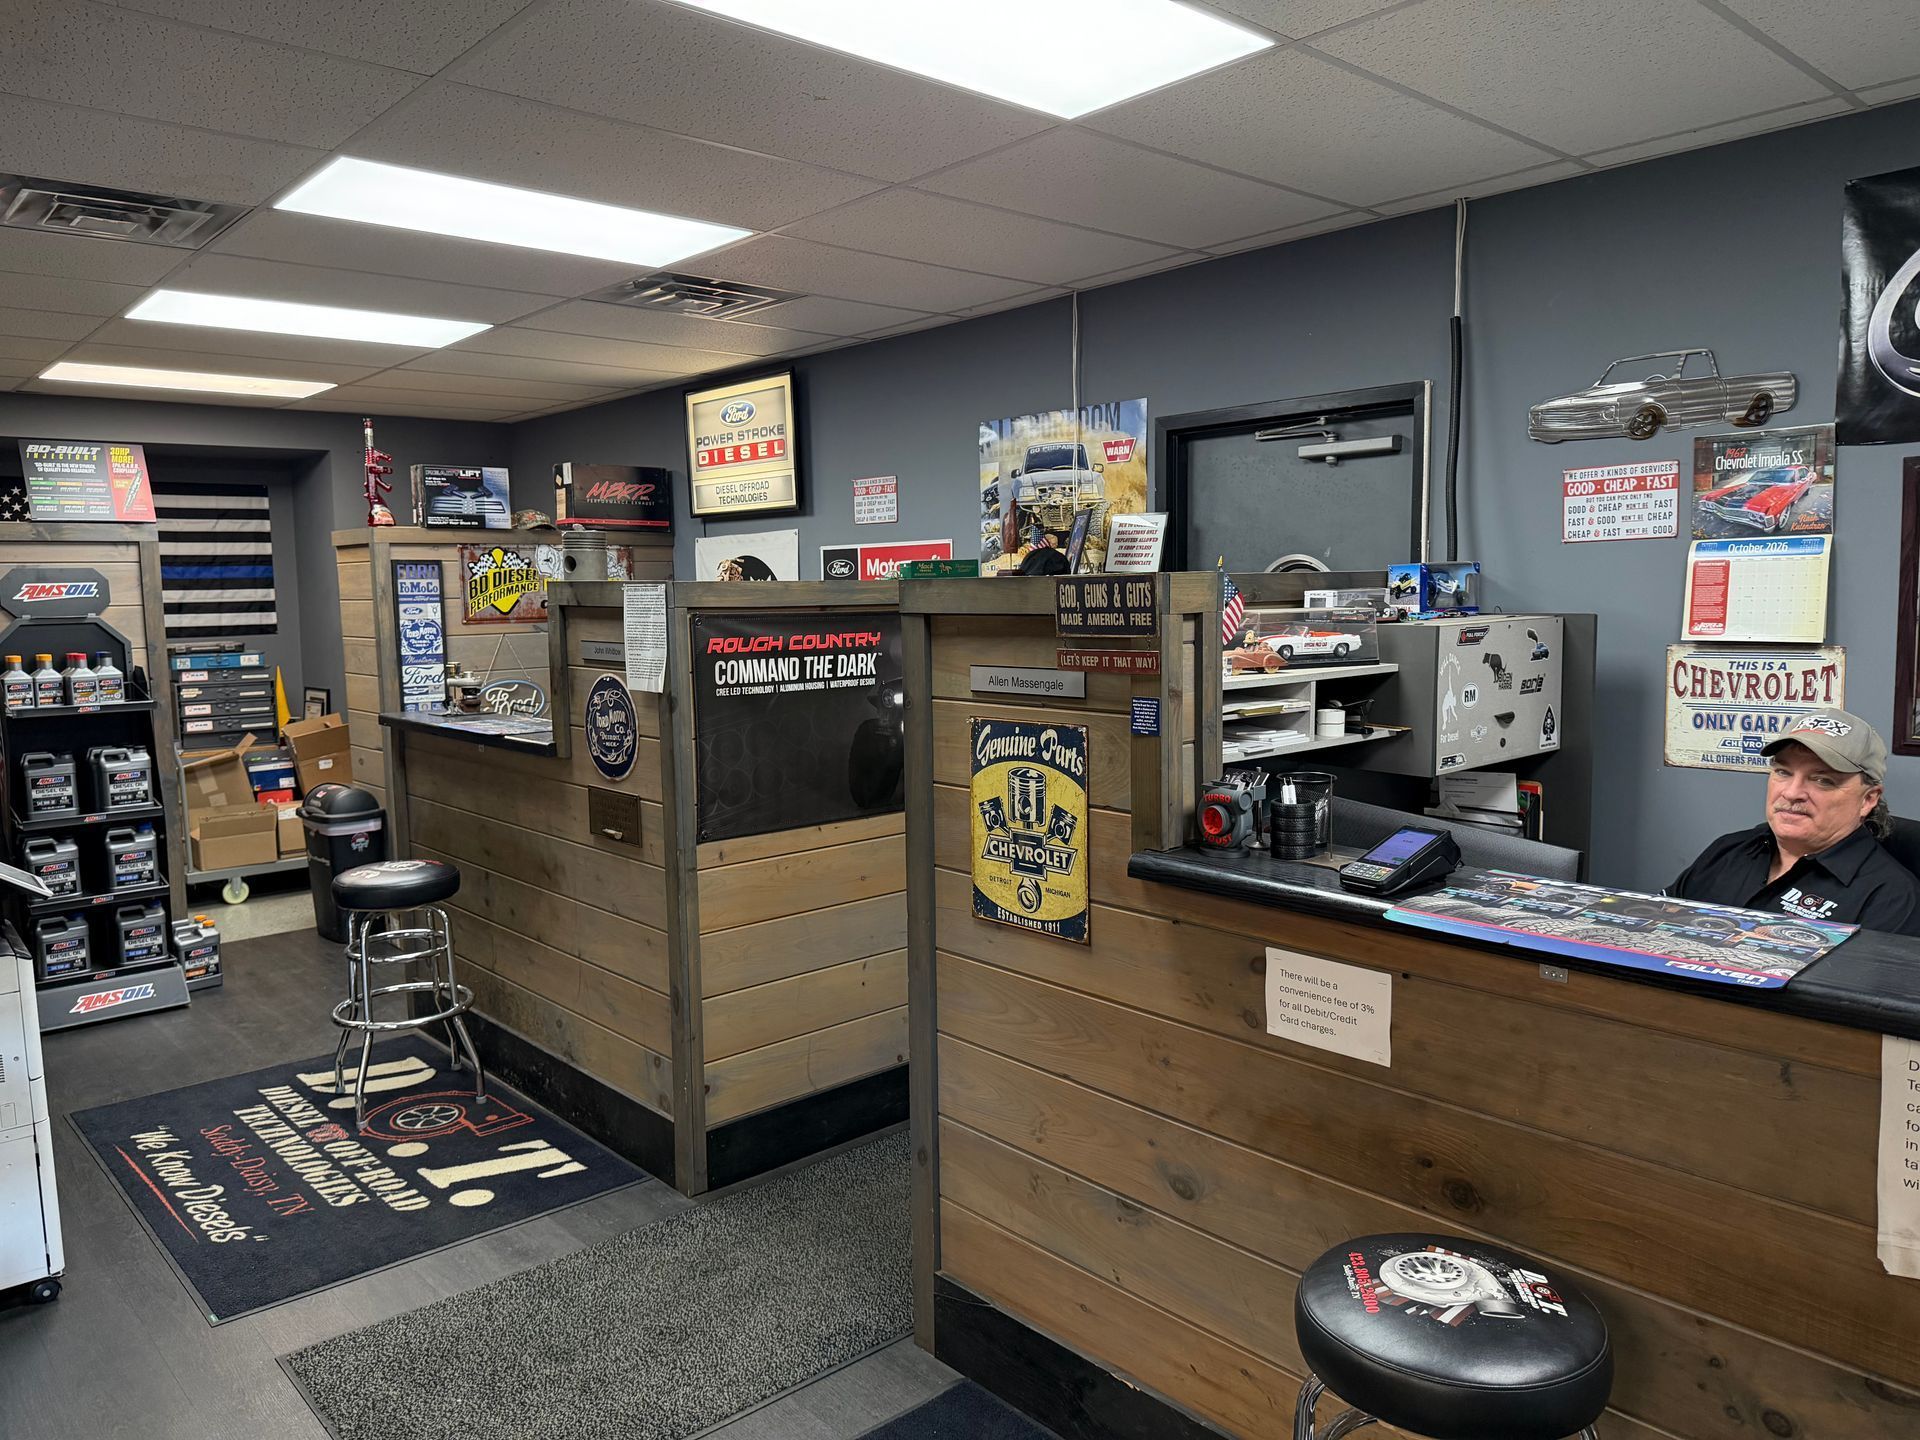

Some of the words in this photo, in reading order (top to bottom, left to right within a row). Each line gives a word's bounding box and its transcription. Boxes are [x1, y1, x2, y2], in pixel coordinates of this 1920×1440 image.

[726, 405, 749, 422] Ford
[696, 432, 734, 448] POWER
[737, 423, 785, 440] STROKE
[26, 444, 101, 455] BD-BUILT
[26, 452, 97, 461] INJECTORS
[699, 441, 784, 465] DIESEL
[1107, 446, 1130, 457] WARN
[1725, 447, 1748, 459] 1967
[112, 455, 134, 464] MORE!
[1715, 454, 1757, 470] Chevrolet
[1759, 451, 1790, 469] Impala
[1791, 450, 1803, 465] SS
[1568, 472, 1577, 480] WE
[1579, 470, 1598, 479] OFFER
[1600, 470, 1605, 478] 3
[1607, 468, 1628, 477] KINDS
[1629, 467, 1638, 475] OF
[1640, 464, 1673, 474] SERVICES
[586, 481, 655, 500] MBRP
[716, 483, 738, 495] DIESEL
[739, 481, 769, 492] OFFROAD
[1567, 483, 1596, 495] GOOD
[1603, 478, 1638, 493] CHEAP
[1646, 475, 1675, 489] FAST
[719, 492, 768, 505] TECHNOLOGIES
[1568, 505, 1586, 514] GOOD
[1589, 505, 1595, 513] &
[1598, 503, 1622, 512] CHEAP
[1654, 499, 1673, 508] FAST
[1568, 518, 1585, 526] FAST
[1588, 517, 1594, 525] &
[1597, 516, 1616, 525] GOOD
[1647, 512, 1673, 521] CHEAP
[1567, 530, 1591, 539] CHEAP
[1594, 529, 1600, 537] &
[1603, 528, 1621, 537] FAST
[1653, 525, 1673, 534] GOOD
[1727, 543, 1764, 554] October
[1766, 542, 1788, 553] 2026
[397, 564, 438, 579] FORD
[832, 562, 850, 575] Ford
[12, 582, 99, 602] AMSOIL
[400, 581, 439, 593] FoMoCo
[469, 575, 489, 600] BD
[493, 568, 538, 589] DIESEL
[470, 582, 539, 617] PERFORMANCE
[1060, 584, 1080, 612] GOD,
[1084, 583, 1108, 608] GUNS
[1113, 583, 1121, 608] &
[1126, 582, 1151, 607] GUTS
[1061, 613, 1082, 626] MADE
[1087, 613, 1125, 626] AMERICA
[1130, 613, 1152, 626] FREE
[1382, 608, 1390, 618] 3
[707, 635, 783, 654] ROUGH
[789, 631, 881, 650] COUNTRY
[404, 655, 437, 664] Mustang
[1060, 654, 1080, 667] (LET'S
[1082, 656, 1099, 667] KEEP
[1103, 657, 1109, 667] IT
[1113, 657, 1131, 668] THAT
[1135, 657, 1156, 669] WAY)
[1728, 661, 1758, 670] THIS
[1762, 661, 1774, 671] IS
[1777, 662, 1787, 671] A
[403, 666, 445, 685] Ford
[714, 656, 800, 685] COMMAND
[804, 655, 834, 680] THE
[716, 688, 730, 697] CREE
[730, 687, 741, 696] LED
[742, 685, 774, 695] TECHNOLOGY
[779, 682, 804, 692] ALUMINUM
[804, 681, 825, 690] HOUSING
[830, 679, 859, 689] WATERPROOF
[859, 678, 876, 686] DESIGN
[988, 675, 1009, 686] Allen
[1012, 677, 1064, 692] Massengale
[1673, 660, 1838, 704] CHEVROLET
[485, 684, 537, 716] Ford
[1464, 689, 1476, 703] RM
[596, 711, 610, 732] FORD
[609, 708, 627, 727] MOTOR
[614, 724, 626, 734] Co.
[976, 724, 1036, 766] Genuine
[1040, 728, 1083, 776] Parts
[1701, 753, 1715, 763] ALL
[1716, 754, 1744, 765] OTHERS
[1747, 756, 1767, 766] PARK
[1203, 793, 1232, 804] TURBO
[989, 840, 1068, 869] CHEVROLET
[989, 875, 1012, 886] DETROIT
[1045, 887, 1071, 898] MICHIGAN
[997, 907, 1042, 930] ESTABLISHED
[1044, 922, 1060, 933] 1911
[130, 926, 155, 936] AMSOIL
[51, 940, 79, 950] AMSOIL
[1280, 969, 1302, 981] There
[1304, 976, 1319, 986] will
[1320, 979, 1331, 989] be
[1332, 982, 1338, 990] a
[1665, 960, 1768, 982] FALKEN
[69, 983, 156, 1013] AMSOIL
[1279, 985, 1332, 1004] convenience
[1334, 997, 1348, 1008] fee
[1349, 1000, 1359, 1011] of
[1361, 1003, 1375, 1014] 3%
[1279, 998, 1291, 1009] for
[1292, 1003, 1302, 1013] all
[1304, 1004, 1358, 1026] Debit/Credit
[1280, 1013, 1299, 1026] Card
[1301, 1020, 1337, 1036] charges.
[233, 1104, 371, 1207] TECHNOLOGIES
[258, 1085, 329, 1128] DIESEL
[324, 1140, 431, 1211] OFF-ROAD
[200, 1124, 279, 1196] Soddy-Daisy,
[267, 1193, 315, 1216] TN
